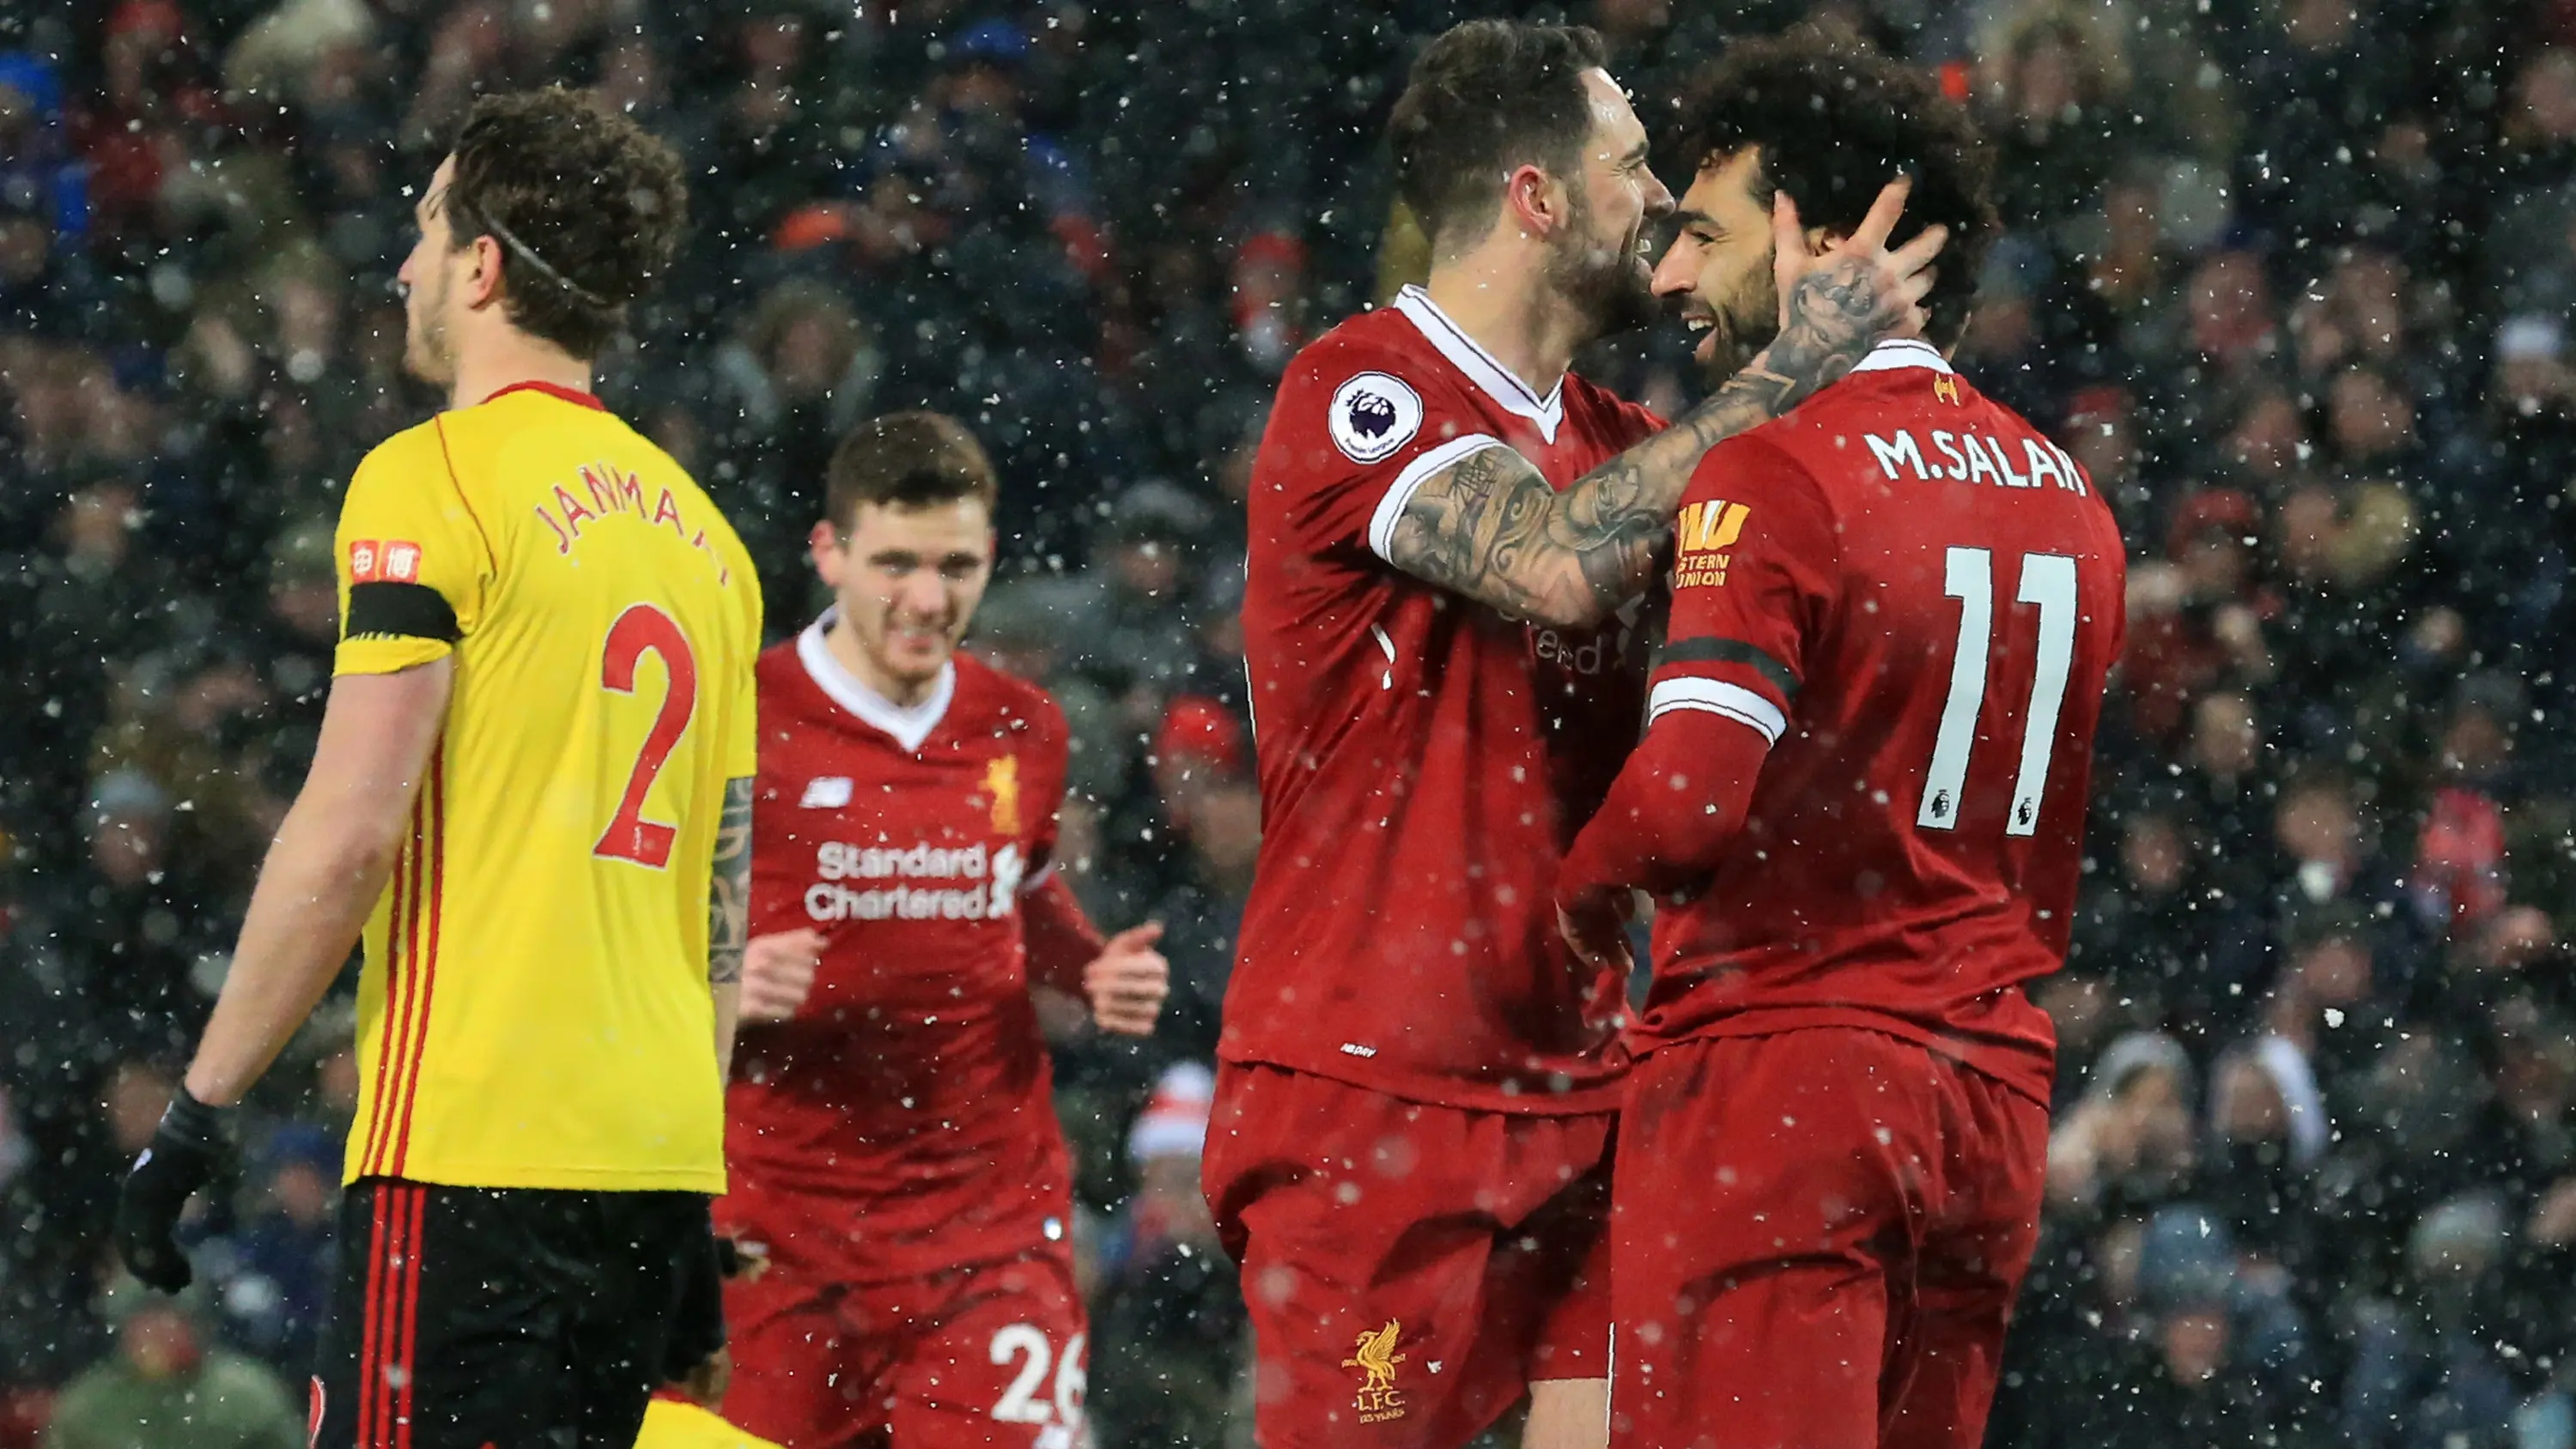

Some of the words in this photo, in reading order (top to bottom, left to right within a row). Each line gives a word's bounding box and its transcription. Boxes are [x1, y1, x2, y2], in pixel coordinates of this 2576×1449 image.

[1863, 428, 2087, 498] M.SALAH
[536, 462, 728, 588] JANMA
[1676, 554, 1730, 573] STERN
[1917, 545, 2078, 836] 11
[592, 601, 697, 870] 2
[805, 883, 987, 921] Chartered
[817, 840, 987, 880] Standard
[989, 1323, 1088, 1428] 26
